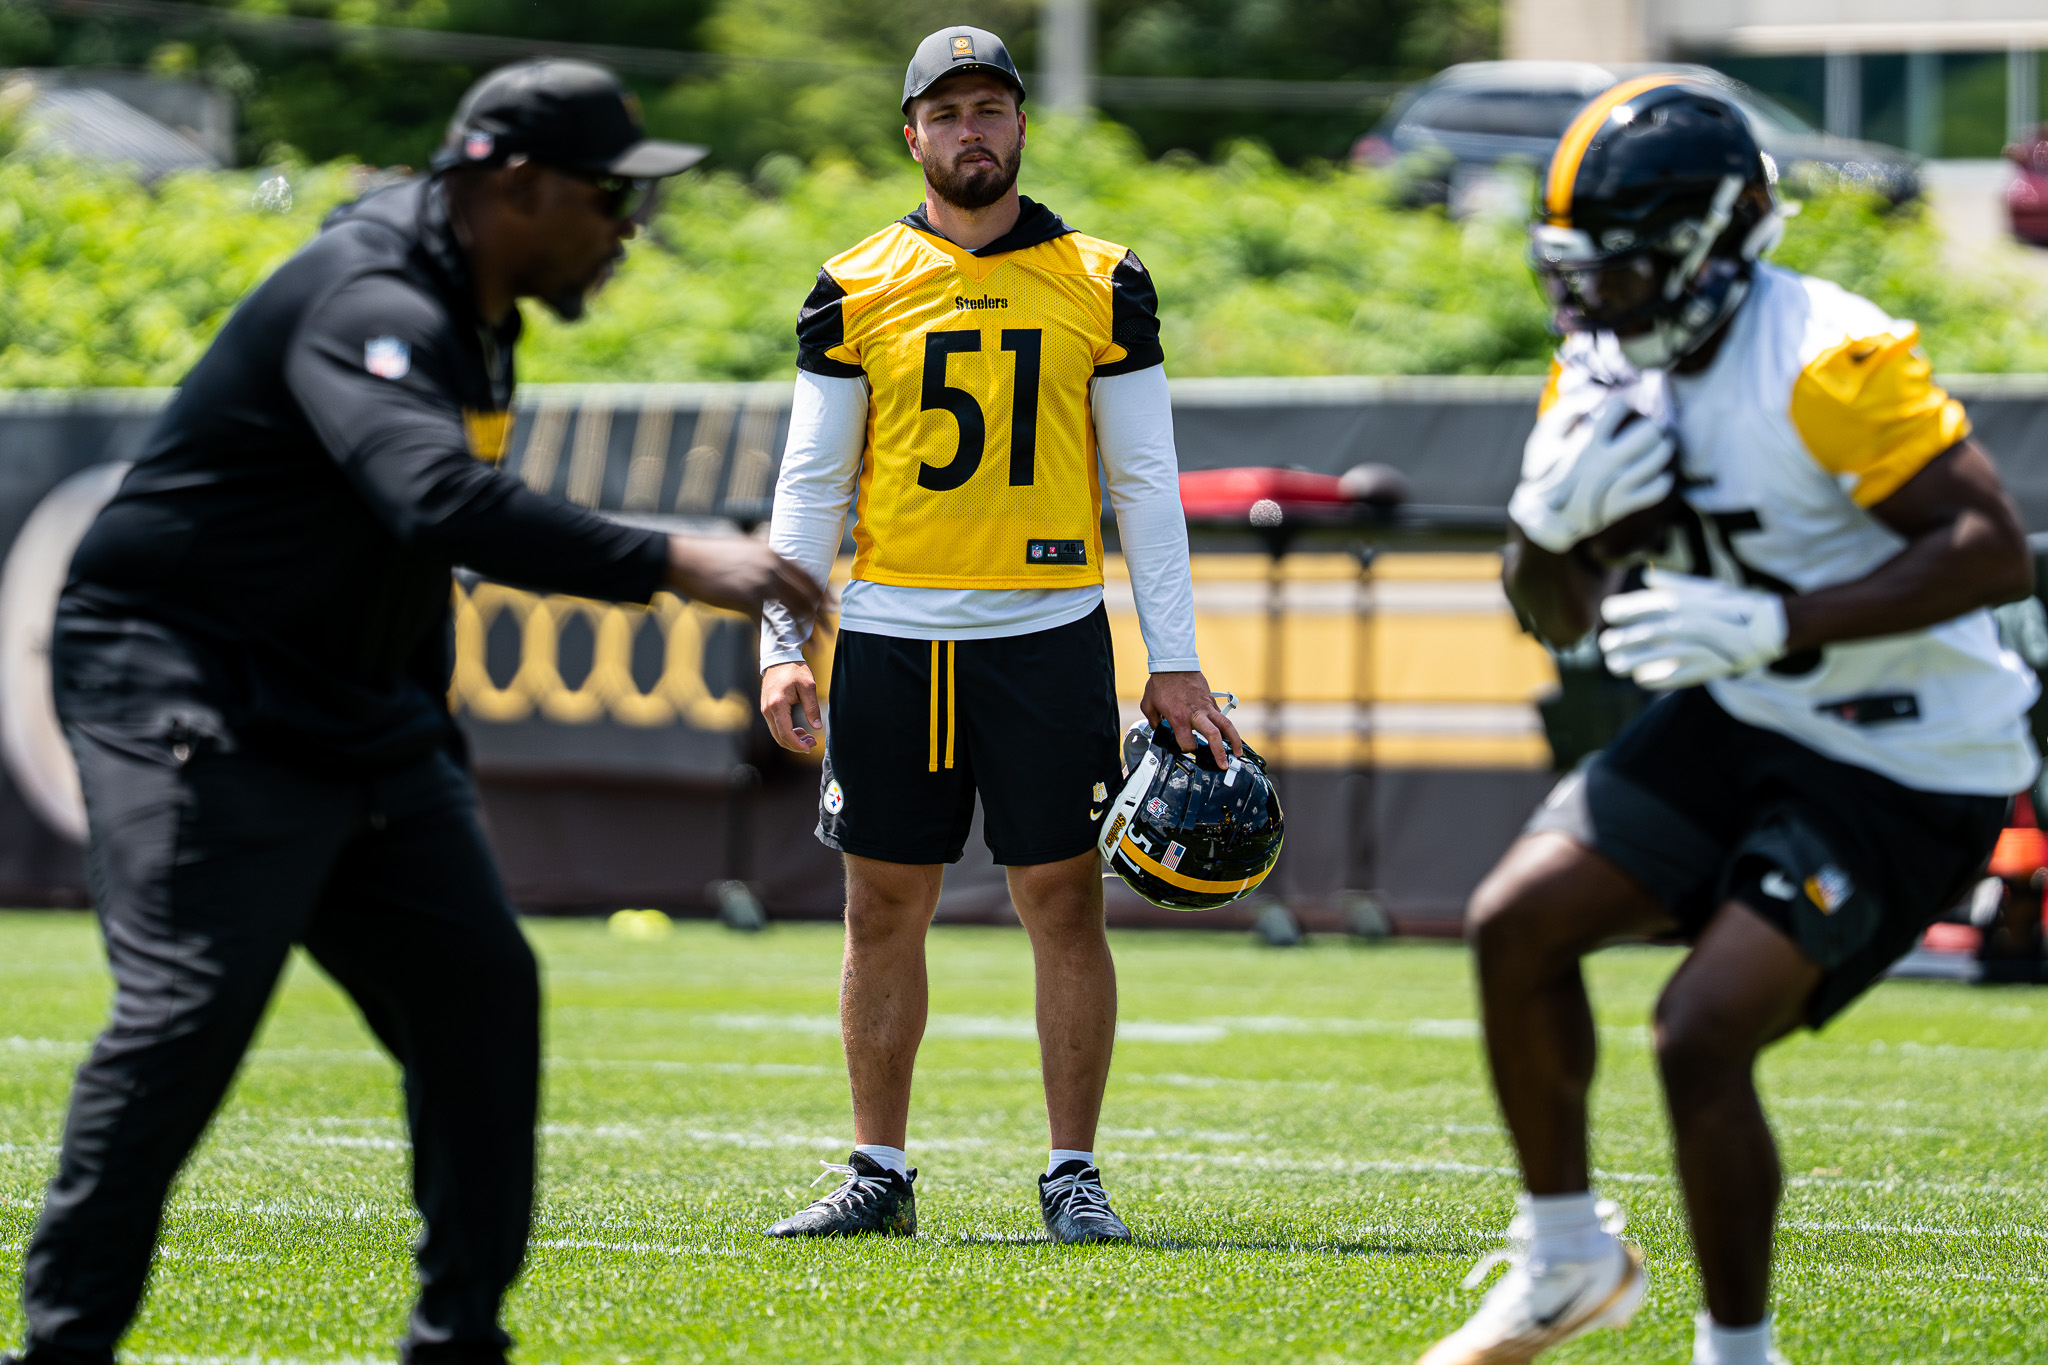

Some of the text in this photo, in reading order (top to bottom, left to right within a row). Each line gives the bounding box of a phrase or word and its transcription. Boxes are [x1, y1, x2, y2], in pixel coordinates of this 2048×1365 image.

[954, 294, 1008, 311] Steelers
[917, 328, 1043, 492] 51
[1104, 812, 1127, 848] Steelers
